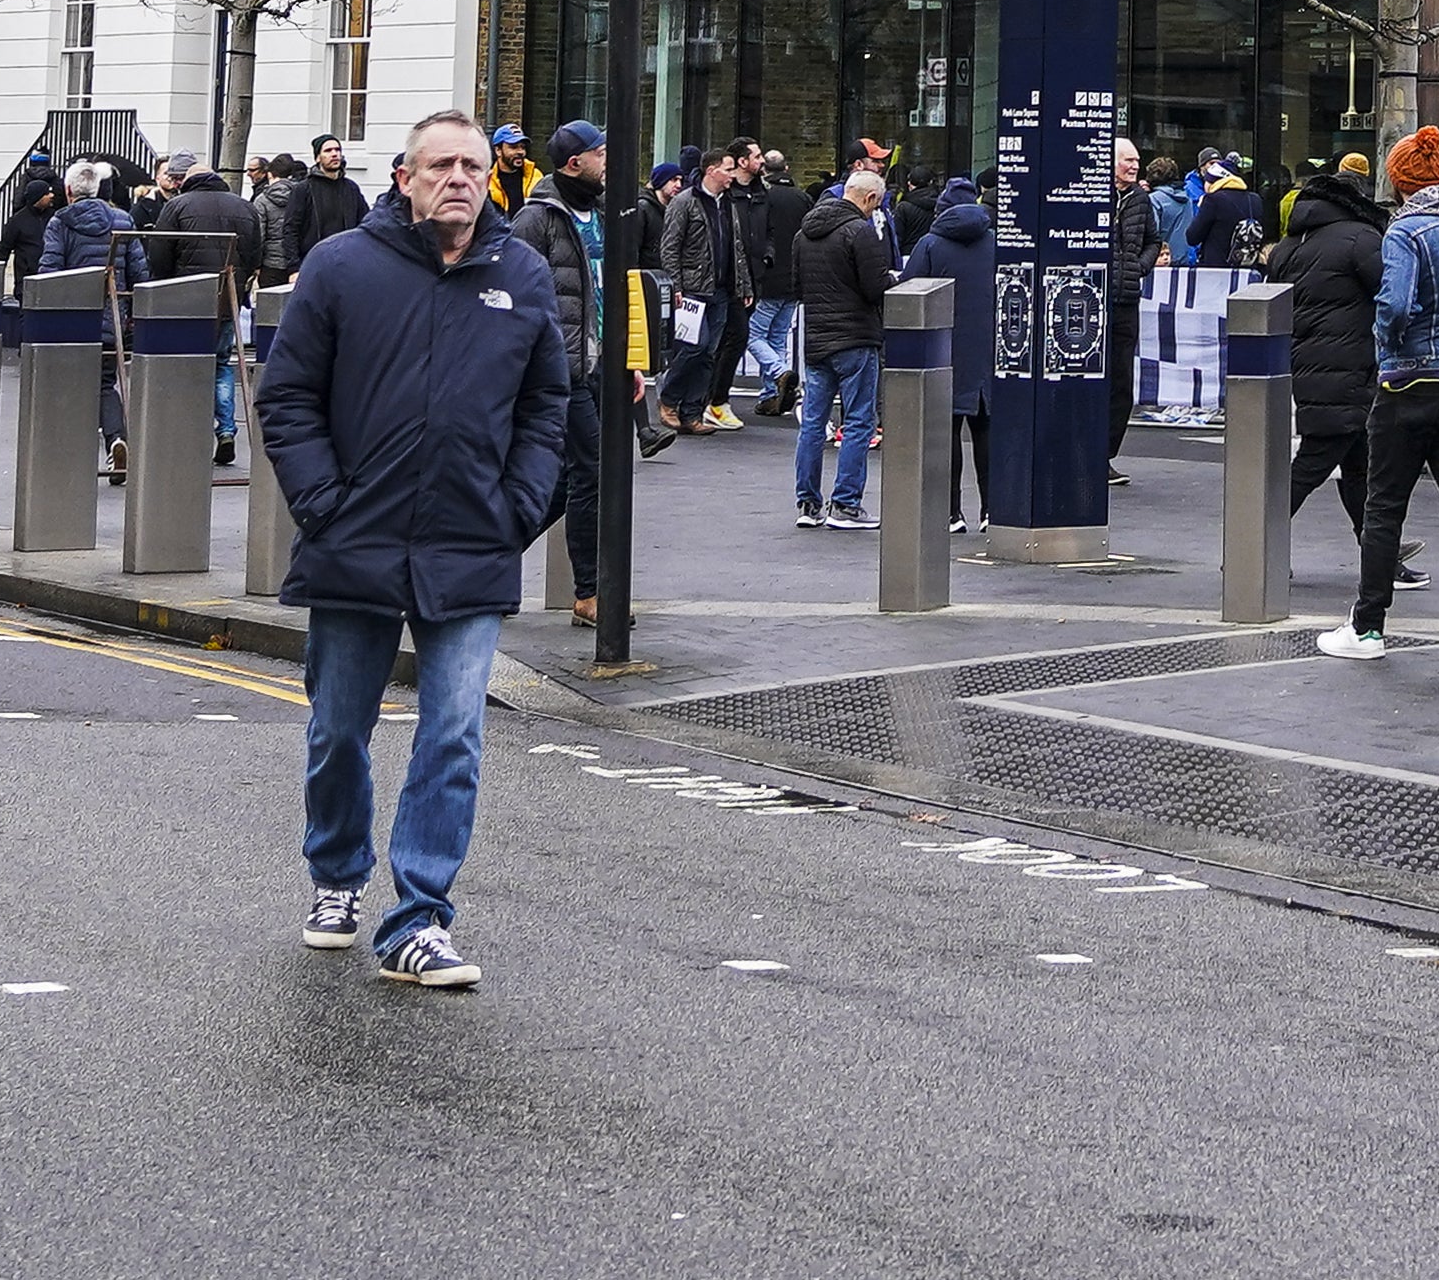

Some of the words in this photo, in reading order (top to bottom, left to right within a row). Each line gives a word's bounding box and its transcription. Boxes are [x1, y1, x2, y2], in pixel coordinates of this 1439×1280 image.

[1068, 109, 1087, 118] West
[1087, 109, 1112, 119] Atrium
[1061, 118, 1086, 128] Paxton
[1086, 119, 1112, 129] Terrace
[1048, 229, 1066, 238] Park
[1066, 229, 1083, 239] Lane
[1084, 229, 1110, 240] Square
[1067, 239, 1084, 249] East
[1084, 240, 1109, 249] Atrium
